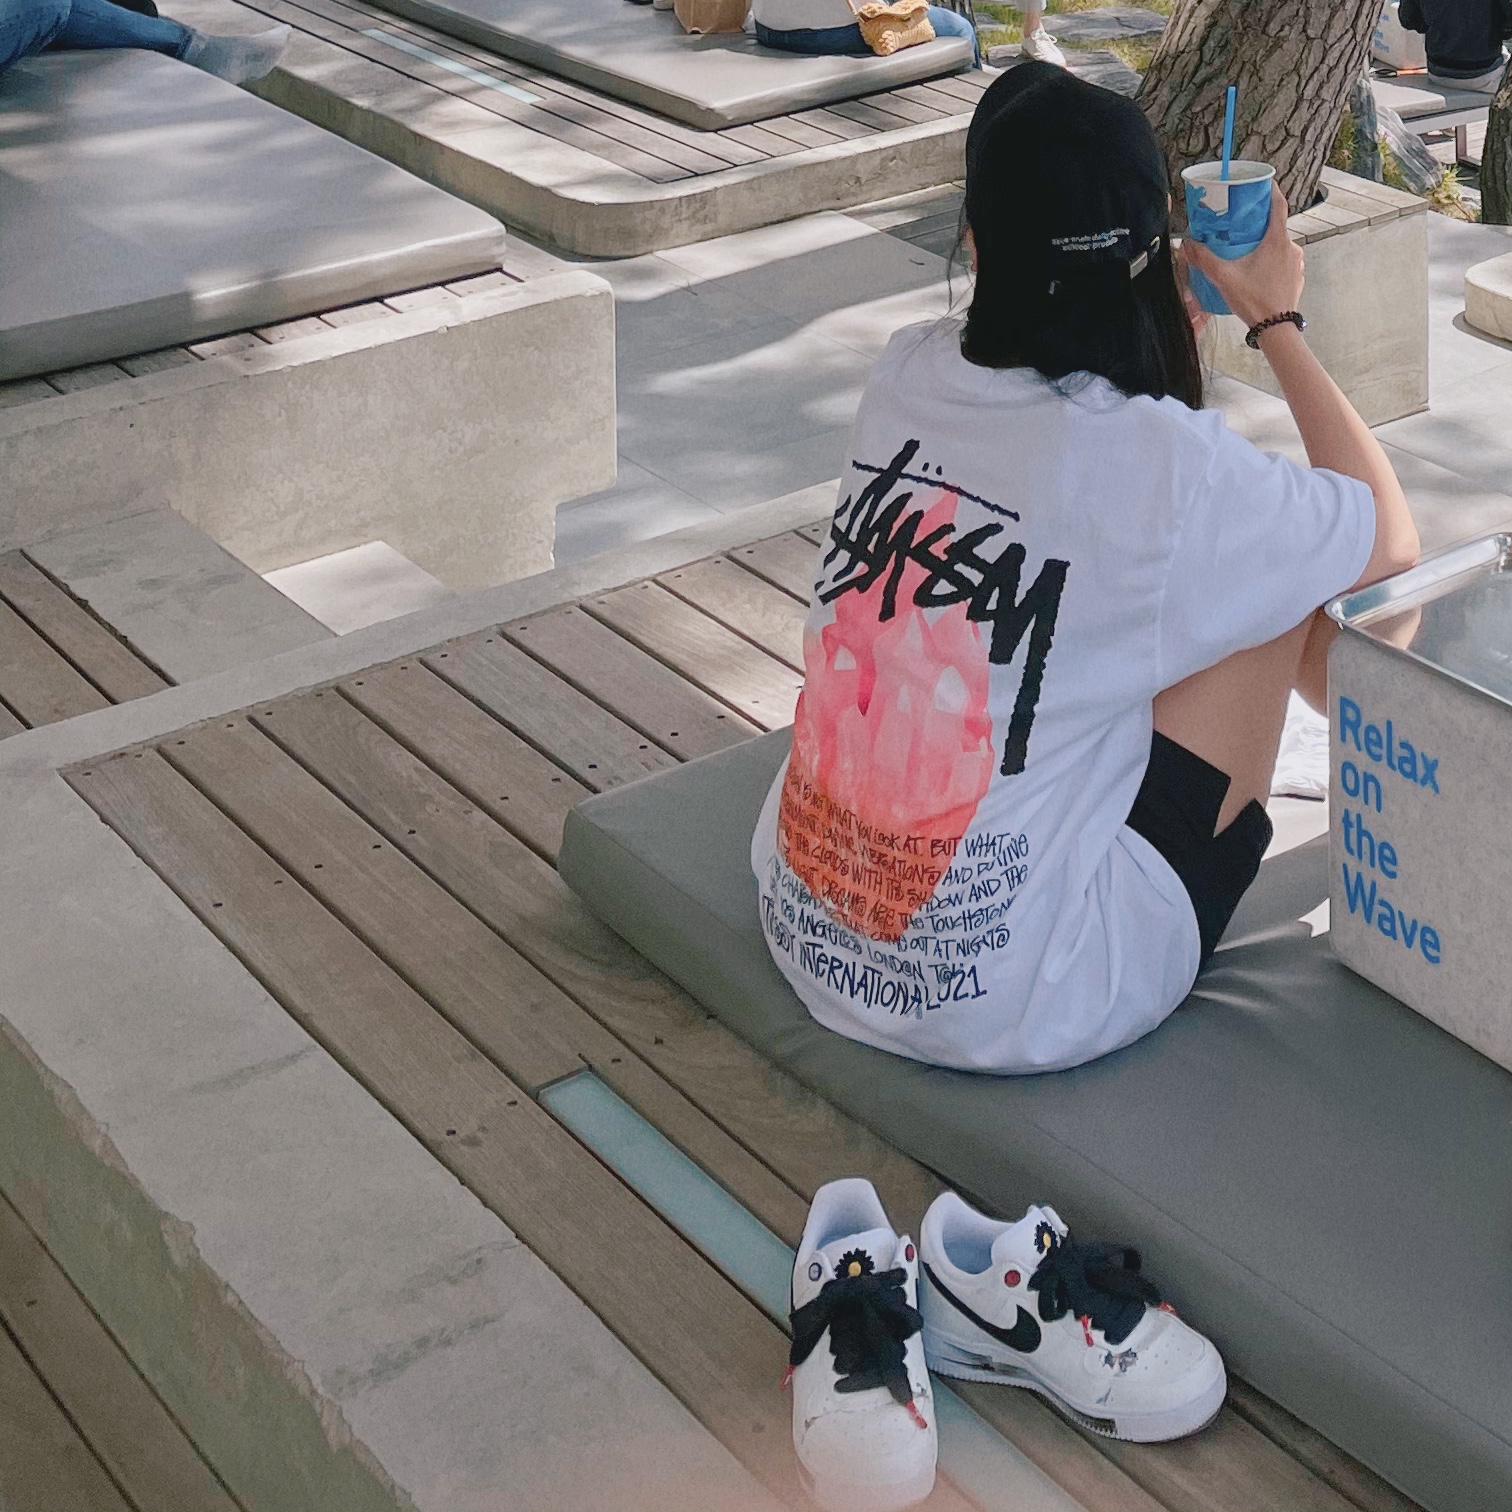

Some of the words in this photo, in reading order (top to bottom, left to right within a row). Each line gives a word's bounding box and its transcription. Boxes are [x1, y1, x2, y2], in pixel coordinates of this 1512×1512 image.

[1339, 695, 1440, 796] Relax
[1340, 760, 1382, 813] on
[874, 829, 901, 851] LOOK
[931, 837, 962, 858] BUT
[964, 832, 1011, 858] WHAT
[1341, 808, 1397, 879] the
[811, 844, 850, 877] CLOUDS
[852, 861, 882, 895] WITH
[968, 878, 1001, 903] AND
[1000, 864, 1028, 892] THE
[942, 865, 973, 886] AND
[1342, 863, 1441, 964] Wave
[867, 942, 926, 984] LONDON
[910, 936, 937, 957] OUT
[933, 939, 957, 960] AT
[799, 940, 930, 1016] INTERNATIONAL
